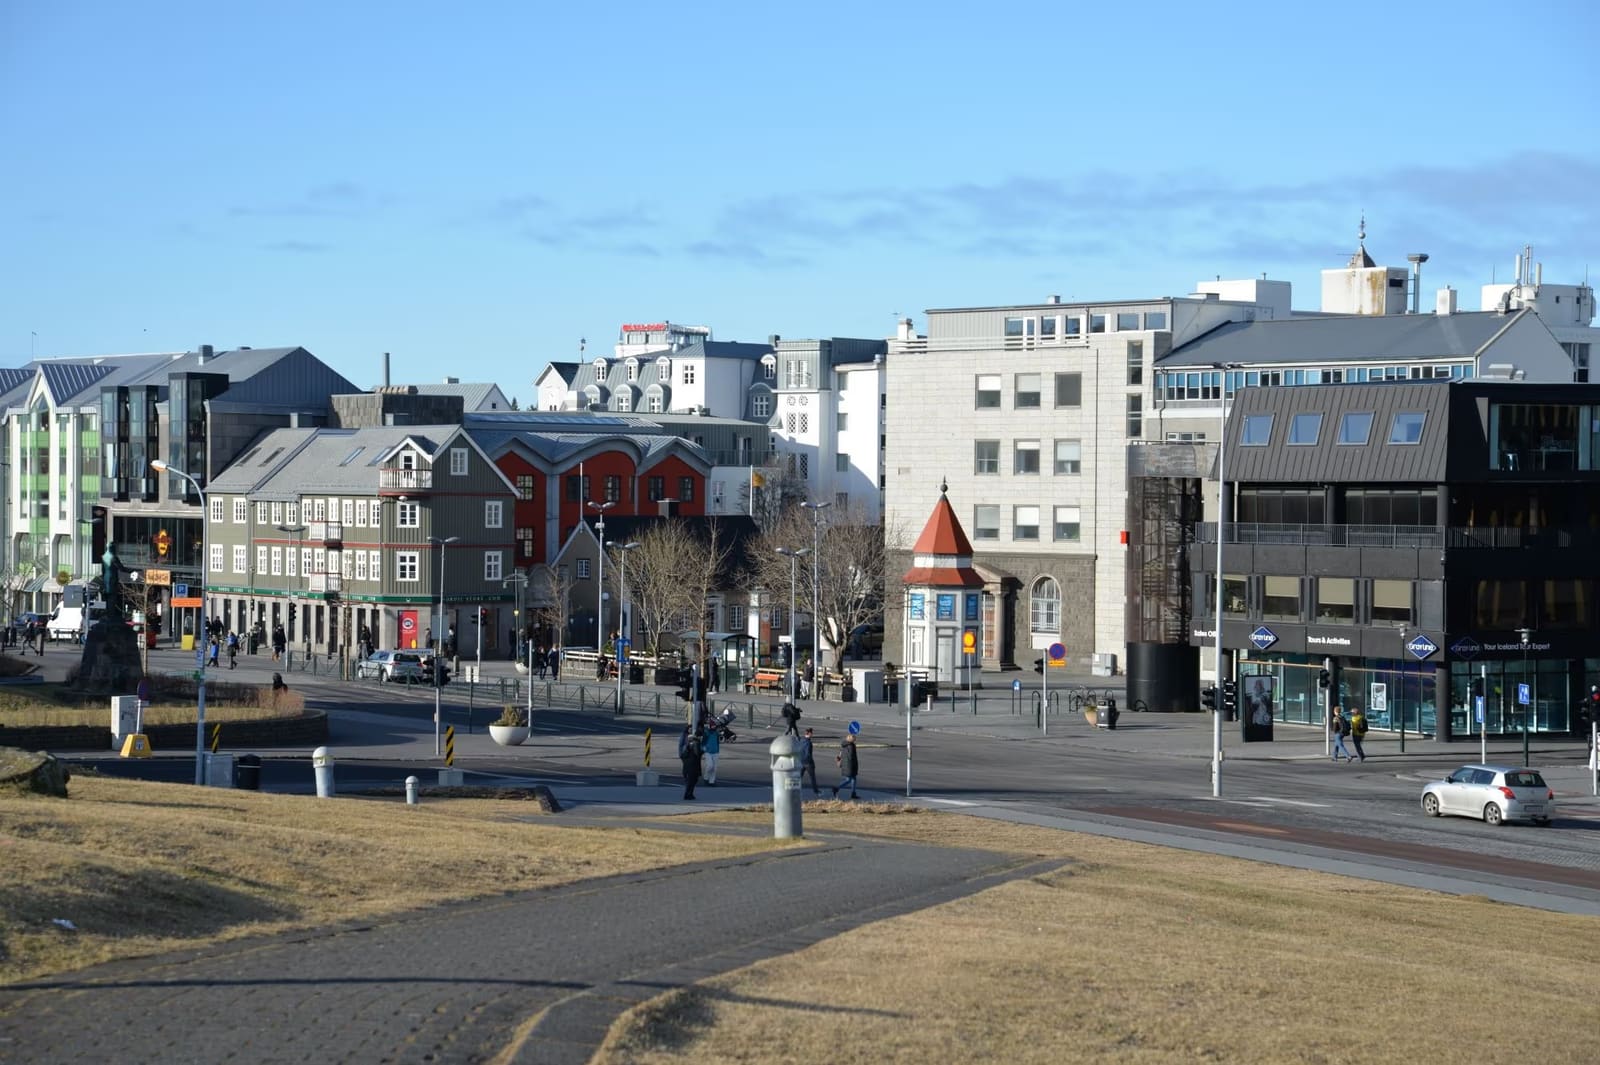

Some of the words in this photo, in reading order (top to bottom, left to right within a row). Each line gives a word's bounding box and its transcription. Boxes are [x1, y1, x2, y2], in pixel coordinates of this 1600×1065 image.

[1307, 636, 1321, 644] Tours
[1326, 637, 1351, 645] Activities
[1483, 643, 1496, 651] Your
[1497, 643, 1519, 651] Iceland
[1532, 643, 1551, 651] Expert
